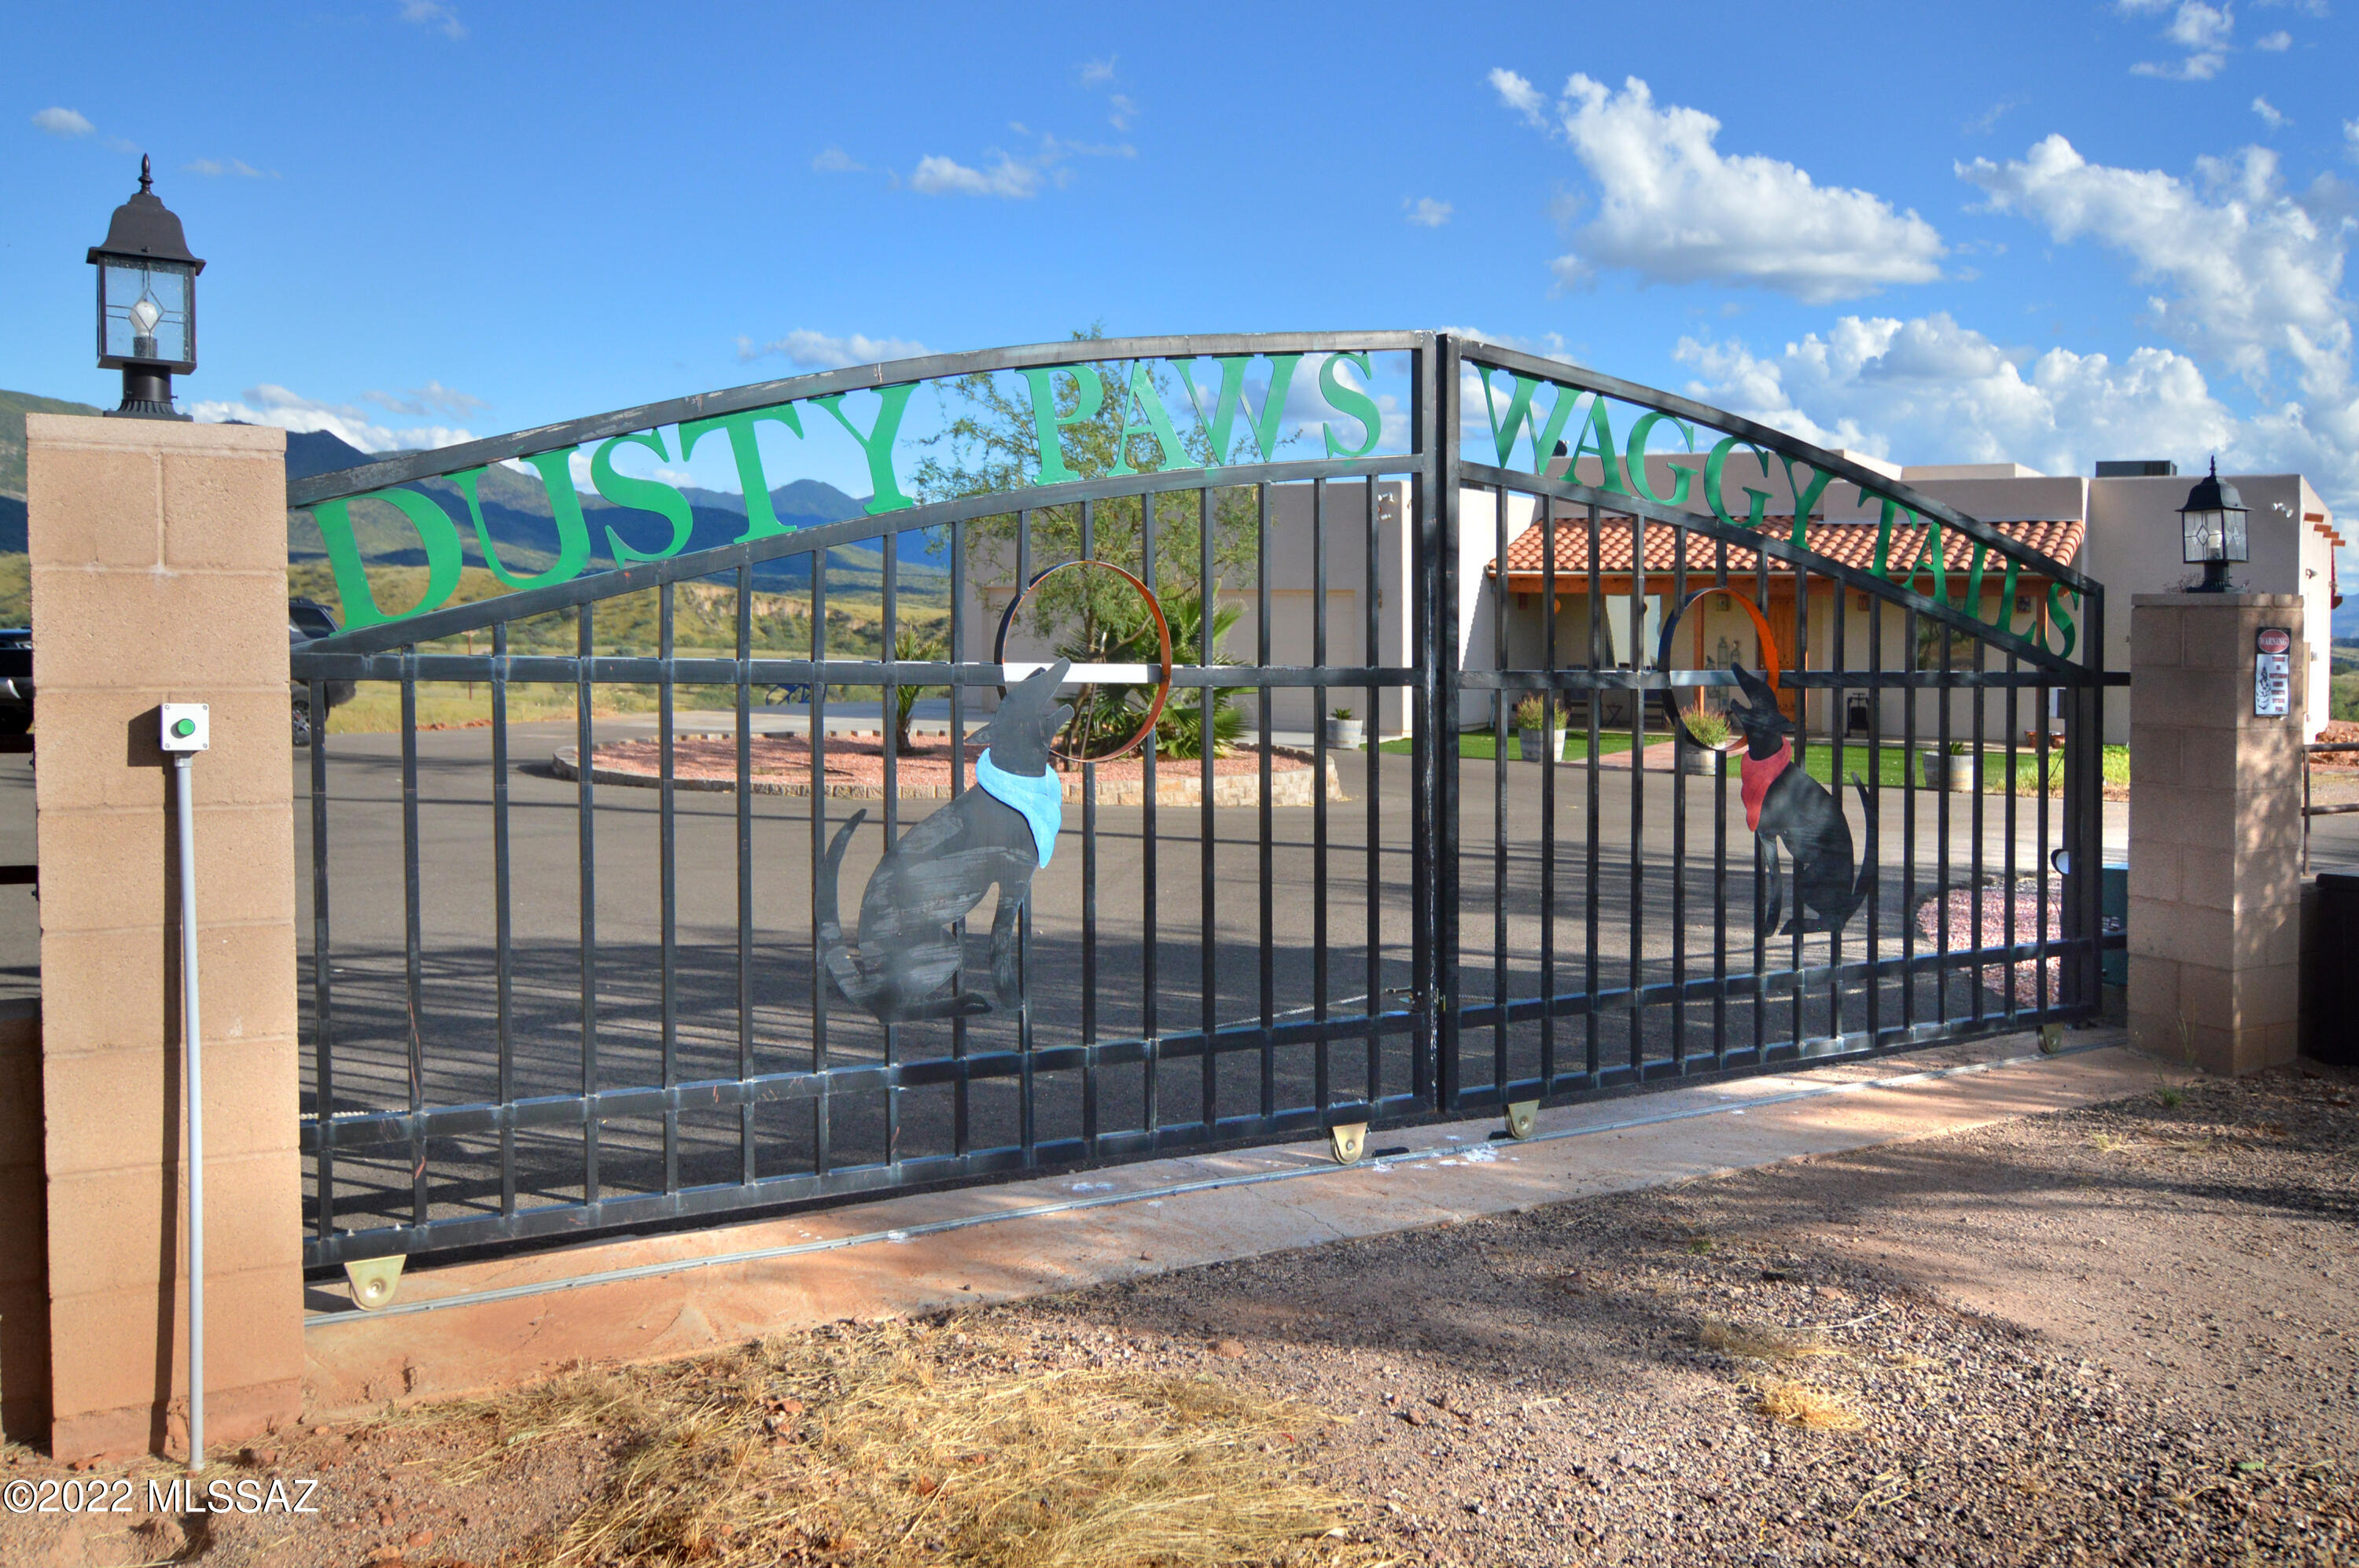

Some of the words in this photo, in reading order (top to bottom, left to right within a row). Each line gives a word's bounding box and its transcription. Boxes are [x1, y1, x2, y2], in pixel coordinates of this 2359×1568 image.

[308, 382, 921, 639] DUSTY
[1015, 350, 1382, 488] PAWS
[1473, 363, 1836, 551] WAGGY
[1858, 486, 2080, 661] TAILS
[2259, 637, 2287, 646] WARNING
